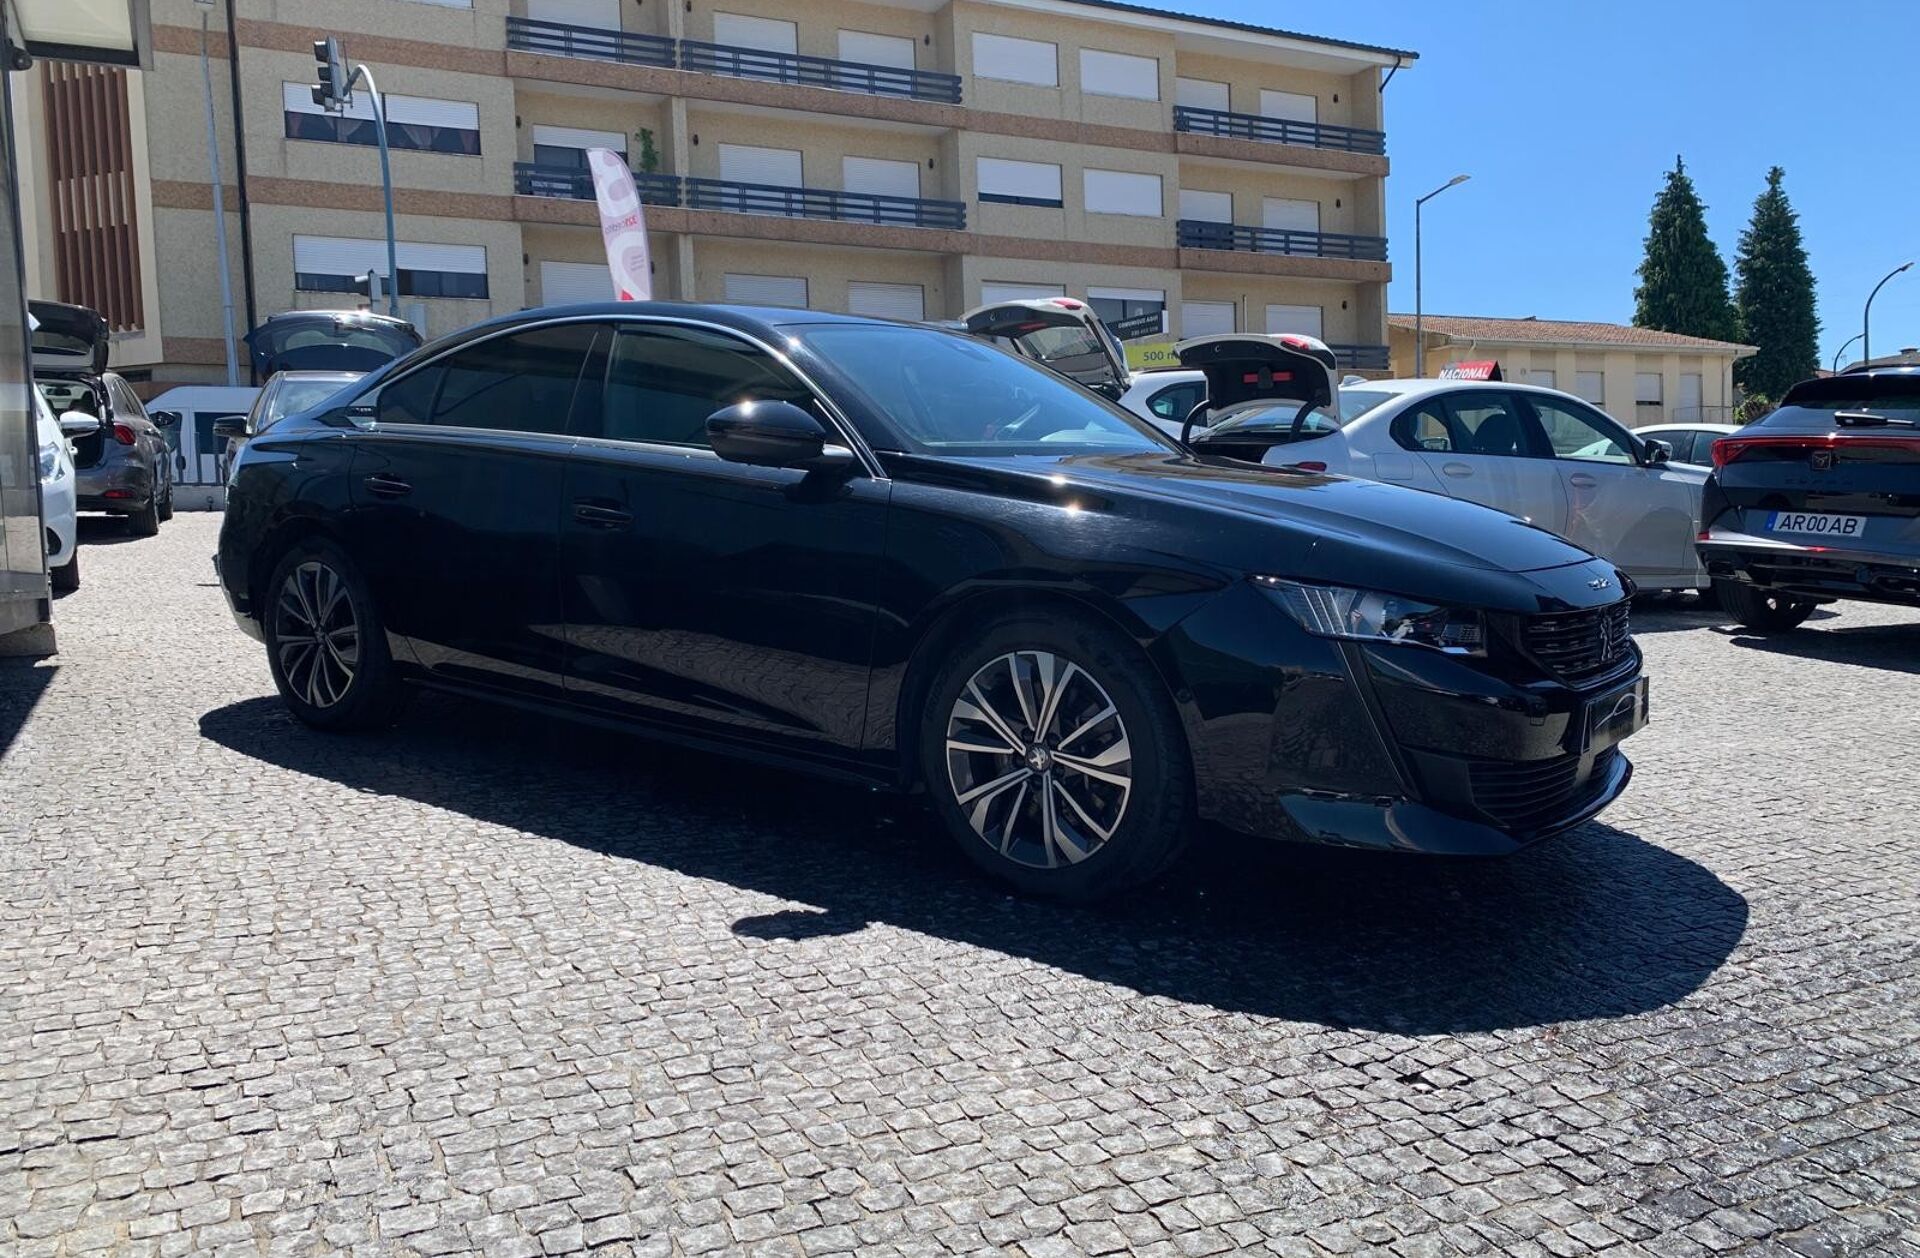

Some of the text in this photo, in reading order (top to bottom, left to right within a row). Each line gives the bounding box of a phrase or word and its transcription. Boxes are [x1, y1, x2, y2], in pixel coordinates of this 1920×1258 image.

[1143, 351, 1164, 361] 500
[1439, 367, 1489, 380] NACIONAL
[1829, 518, 1857, 534] AB
